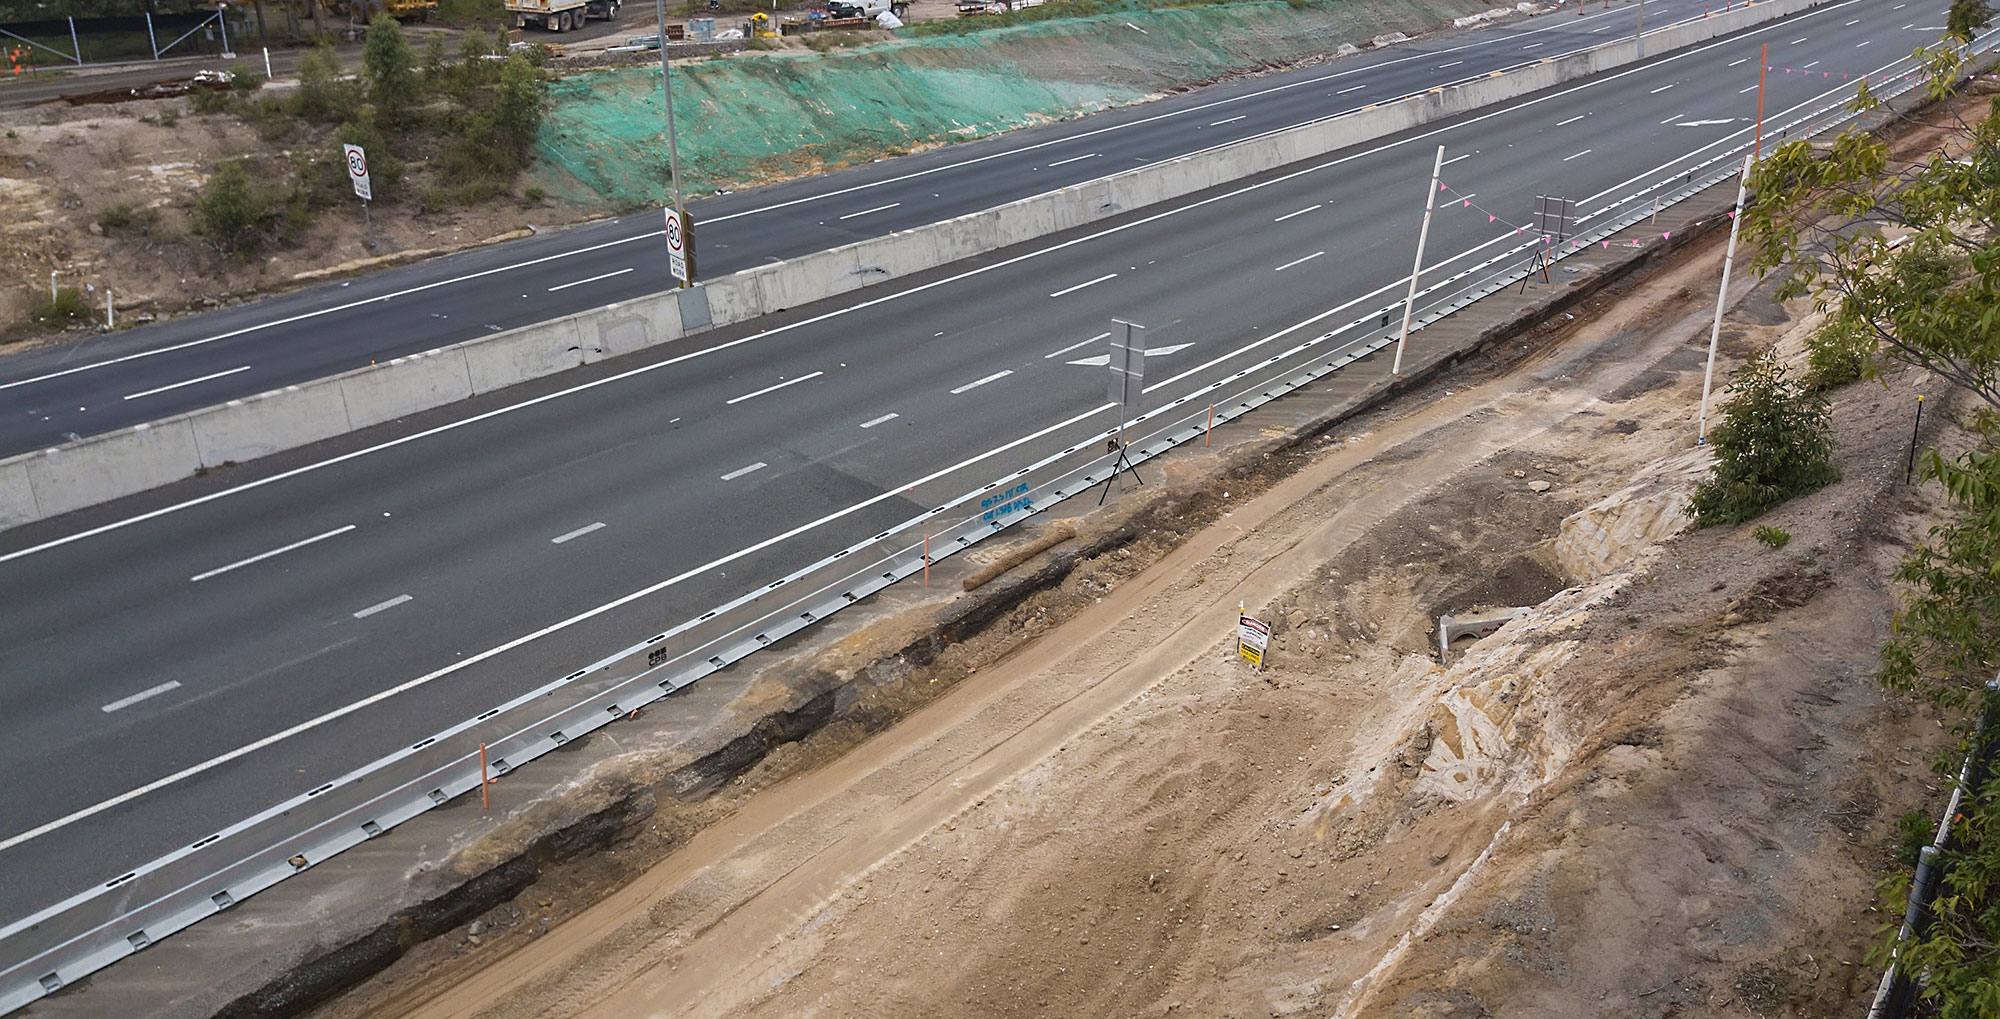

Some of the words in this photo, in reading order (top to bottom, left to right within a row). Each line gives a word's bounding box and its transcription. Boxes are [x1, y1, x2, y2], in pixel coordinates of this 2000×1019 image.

[350, 156, 364, 171] 80
[669, 224, 680, 243] 80
[672, 258, 684, 269] ROAD
[672, 266, 685, 278] WORK
[1245, 620, 1264, 631] DANGER
[649, 653, 667, 666] CPB
